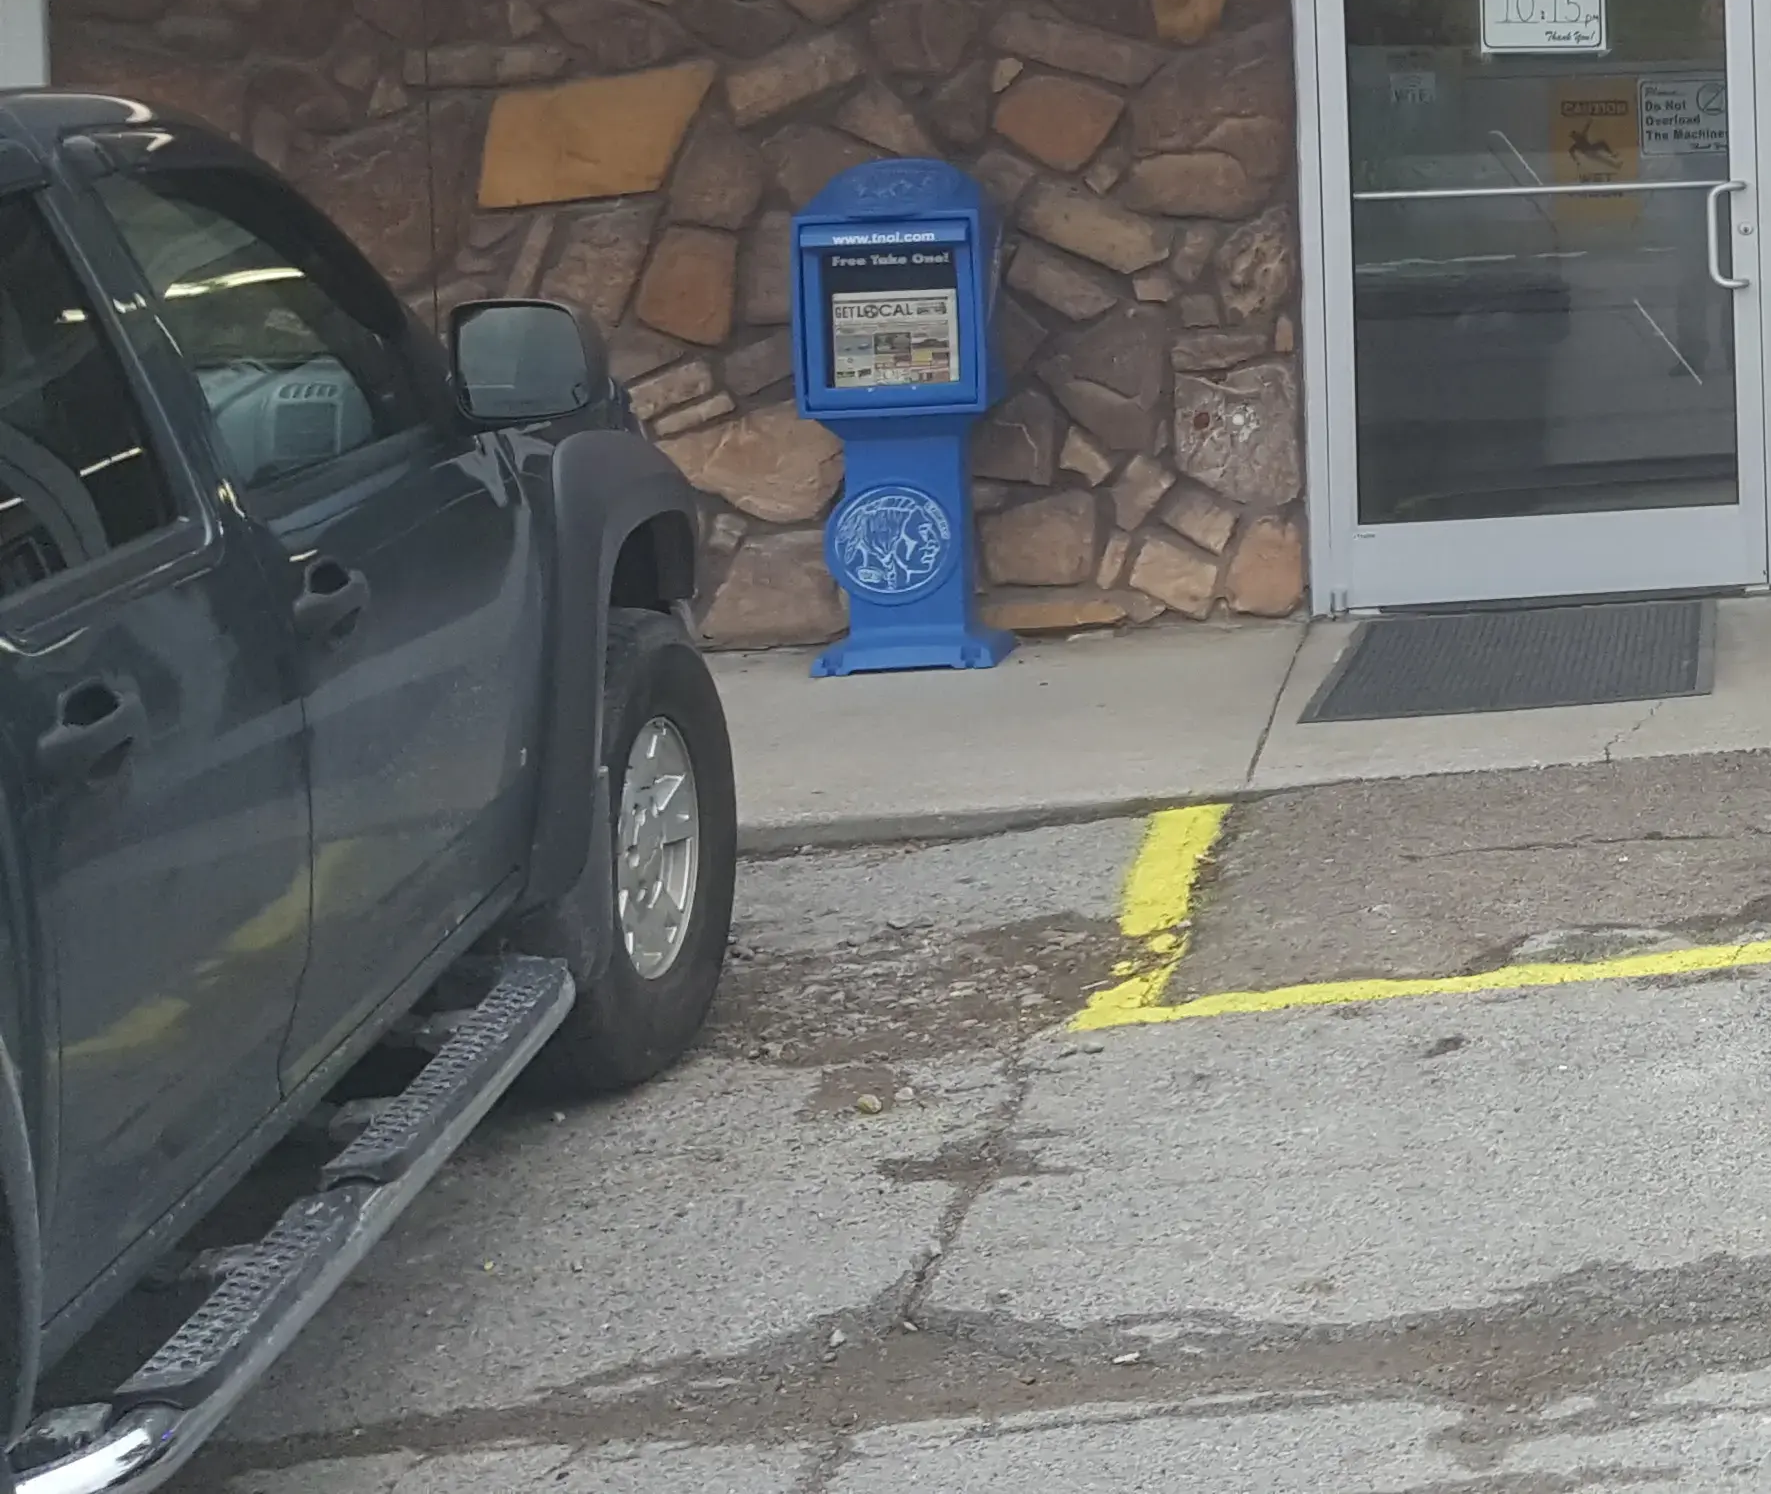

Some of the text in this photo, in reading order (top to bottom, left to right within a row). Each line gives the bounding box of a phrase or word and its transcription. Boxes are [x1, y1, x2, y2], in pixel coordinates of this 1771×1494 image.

[831, 251, 950, 267] Free Take One!
